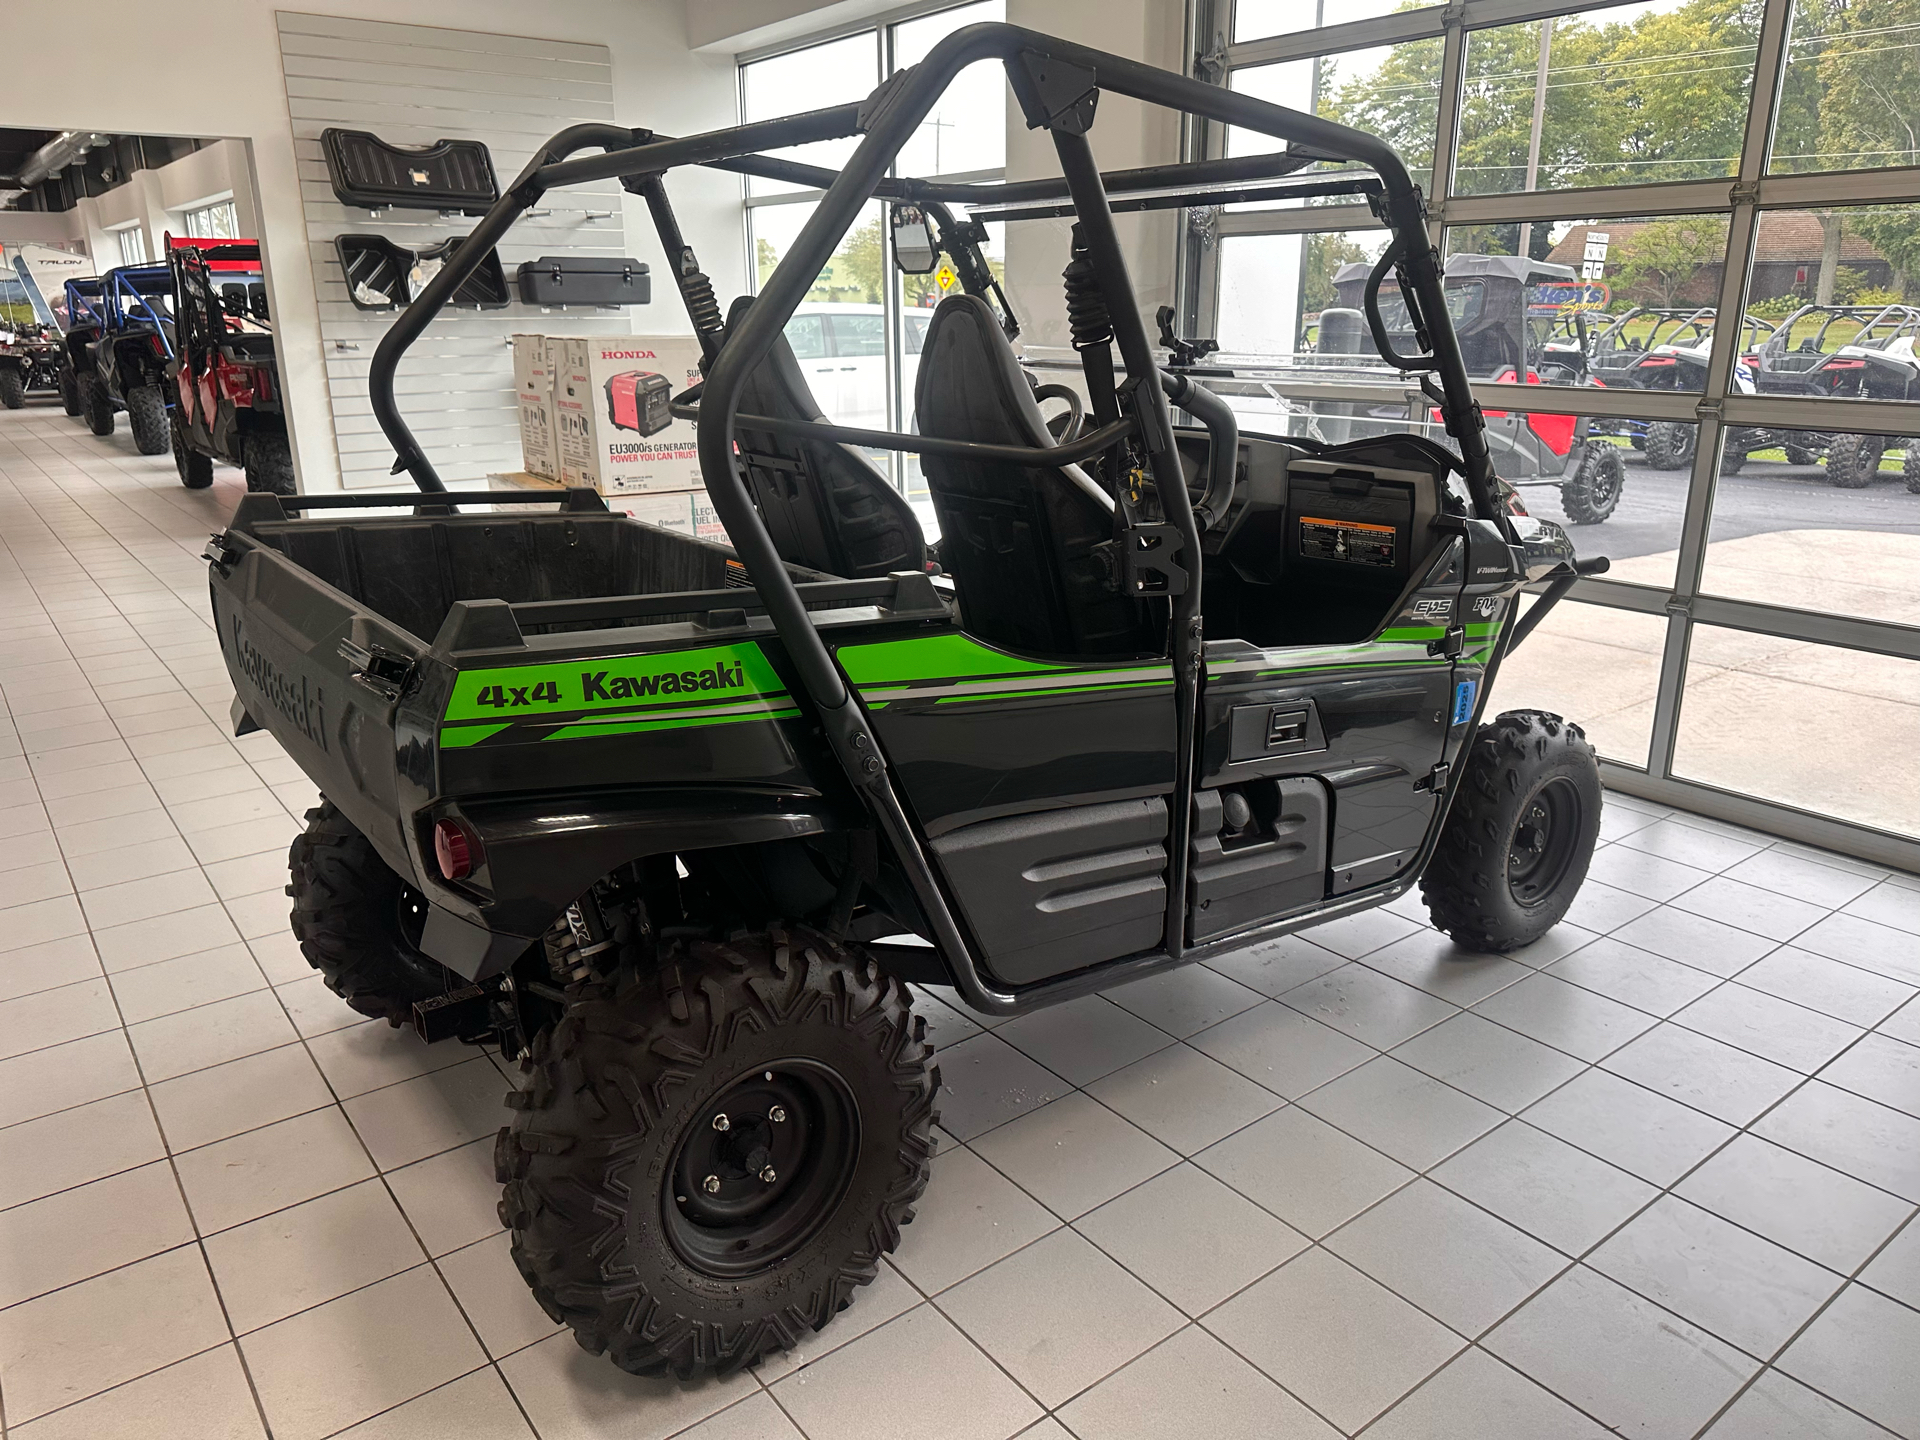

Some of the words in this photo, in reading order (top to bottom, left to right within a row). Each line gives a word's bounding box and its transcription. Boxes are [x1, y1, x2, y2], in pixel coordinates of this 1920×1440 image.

[1557, 298, 1604, 317] Sports
[601, 350, 657, 359] HONDA
[609, 442, 653, 455] EU3000is
[653, 441, 697, 452] GENERATOR
[610, 453, 639, 464] POWER
[640, 452, 655, 462] YOU
[656, 452, 673, 461] CAN
[673, 450, 697, 460] TRUST
[1413, 600, 1452, 616] EPS
[1472, 596, 1499, 615] FOX
[233, 613, 329, 753] Kawasaki
[476, 681, 563, 708] 4x4
[581, 660, 745, 702] Kawasaki
